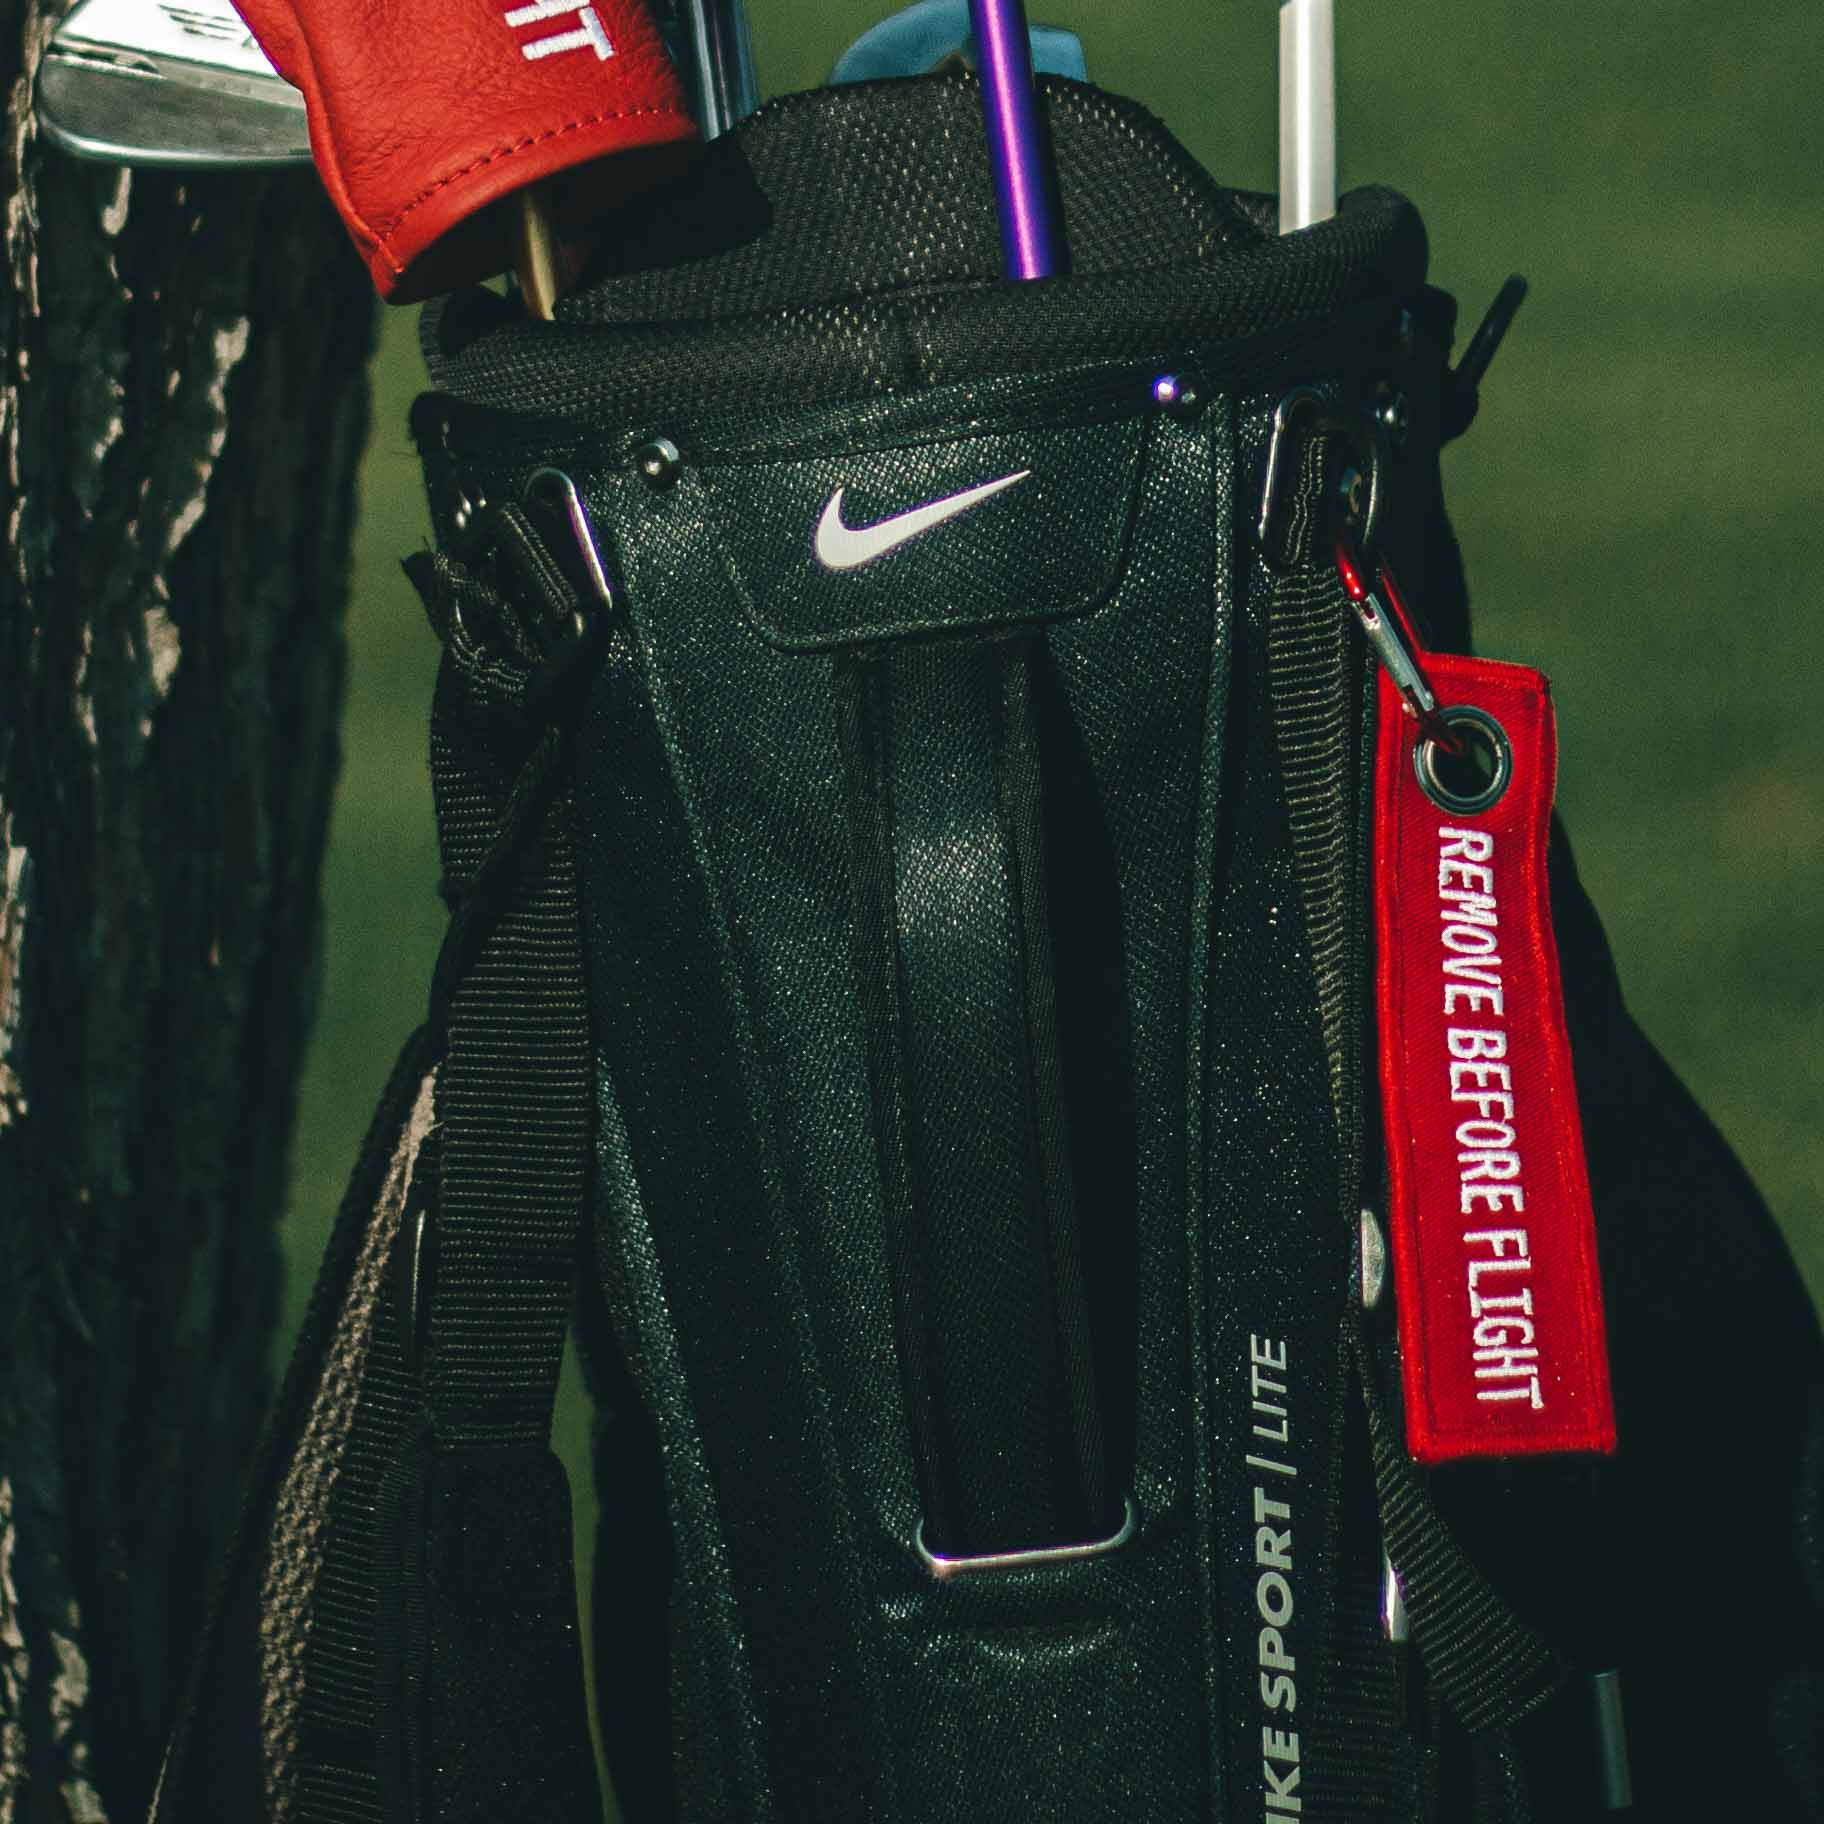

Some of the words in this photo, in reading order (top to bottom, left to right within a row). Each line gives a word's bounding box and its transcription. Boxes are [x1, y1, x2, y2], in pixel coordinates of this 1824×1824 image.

[1436, 825, 1505, 1017] REMOVE
[1446, 1026, 1525, 1216] BEFORE
[1249, 1332, 1290, 1444] LITE
[1461, 1228, 1546, 1411] FLIGHT
[1252, 1485, 1298, 1714] SPORT
[1261, 1724, 1303, 1824] IKE
